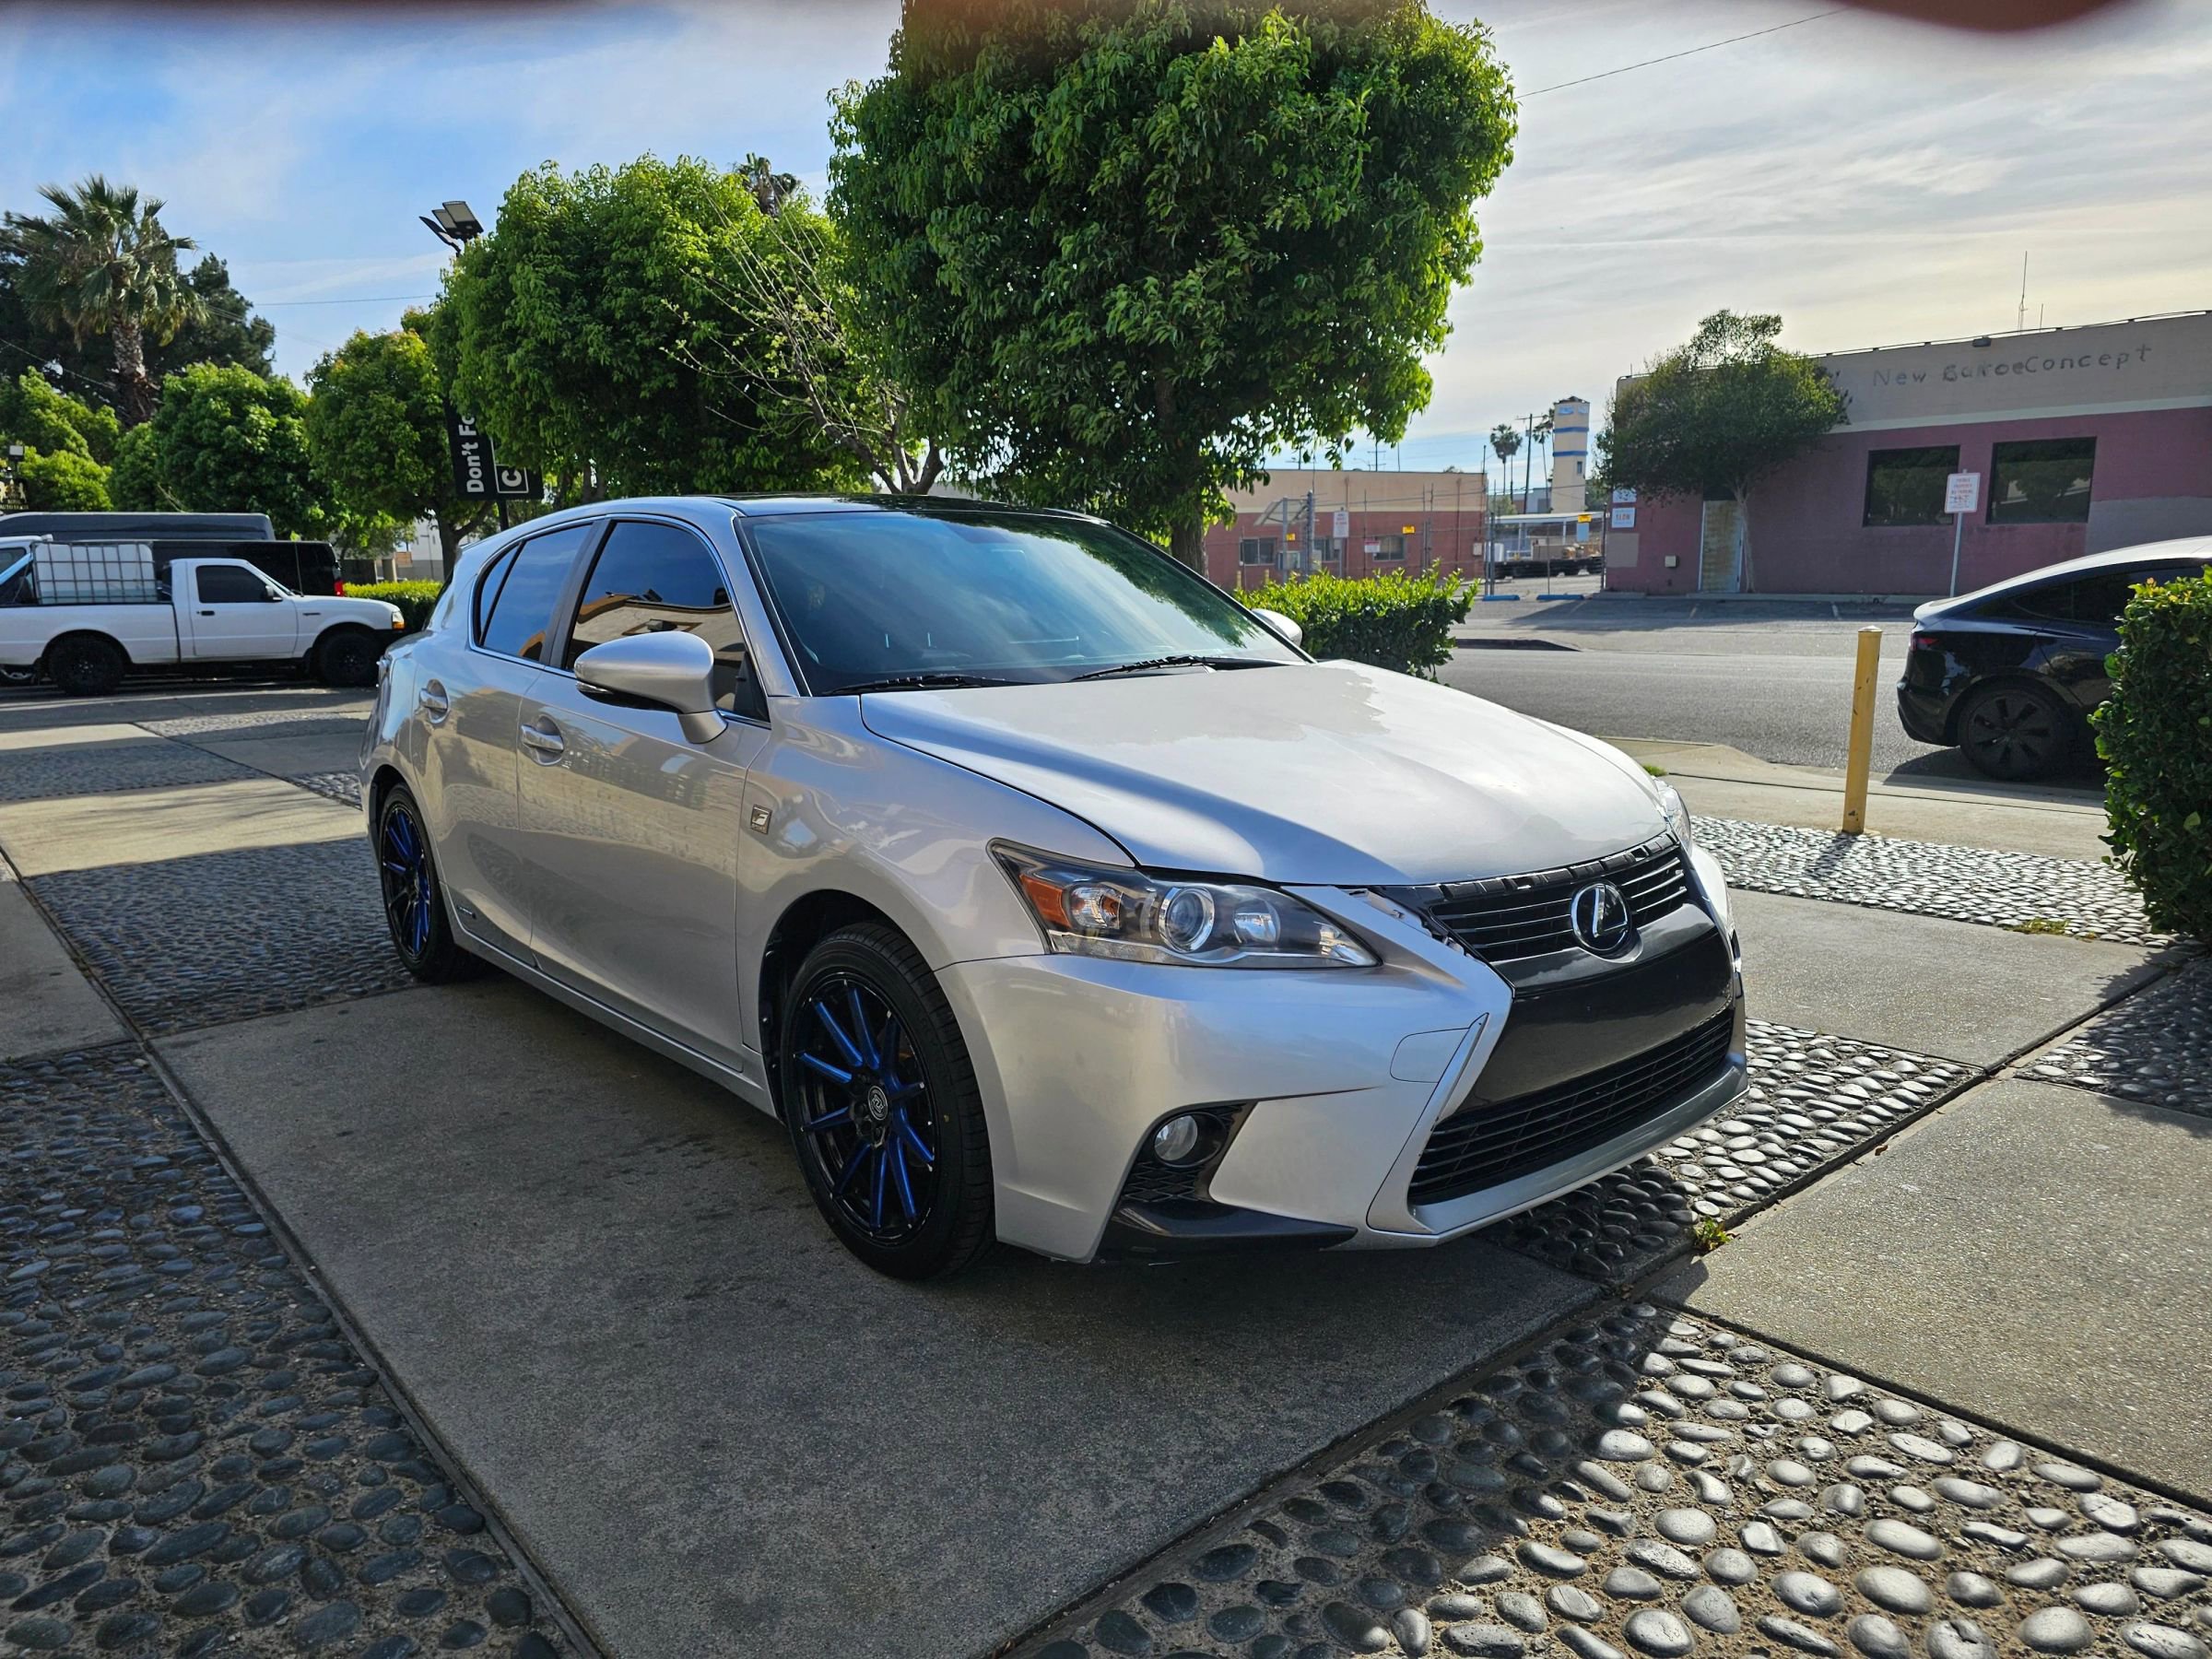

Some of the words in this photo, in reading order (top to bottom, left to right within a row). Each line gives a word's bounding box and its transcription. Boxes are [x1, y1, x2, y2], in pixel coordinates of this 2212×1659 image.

[1873, 370, 1926, 386] New
[2025, 343, 2152, 373] Concept
[461, 442, 485, 493] Don't
